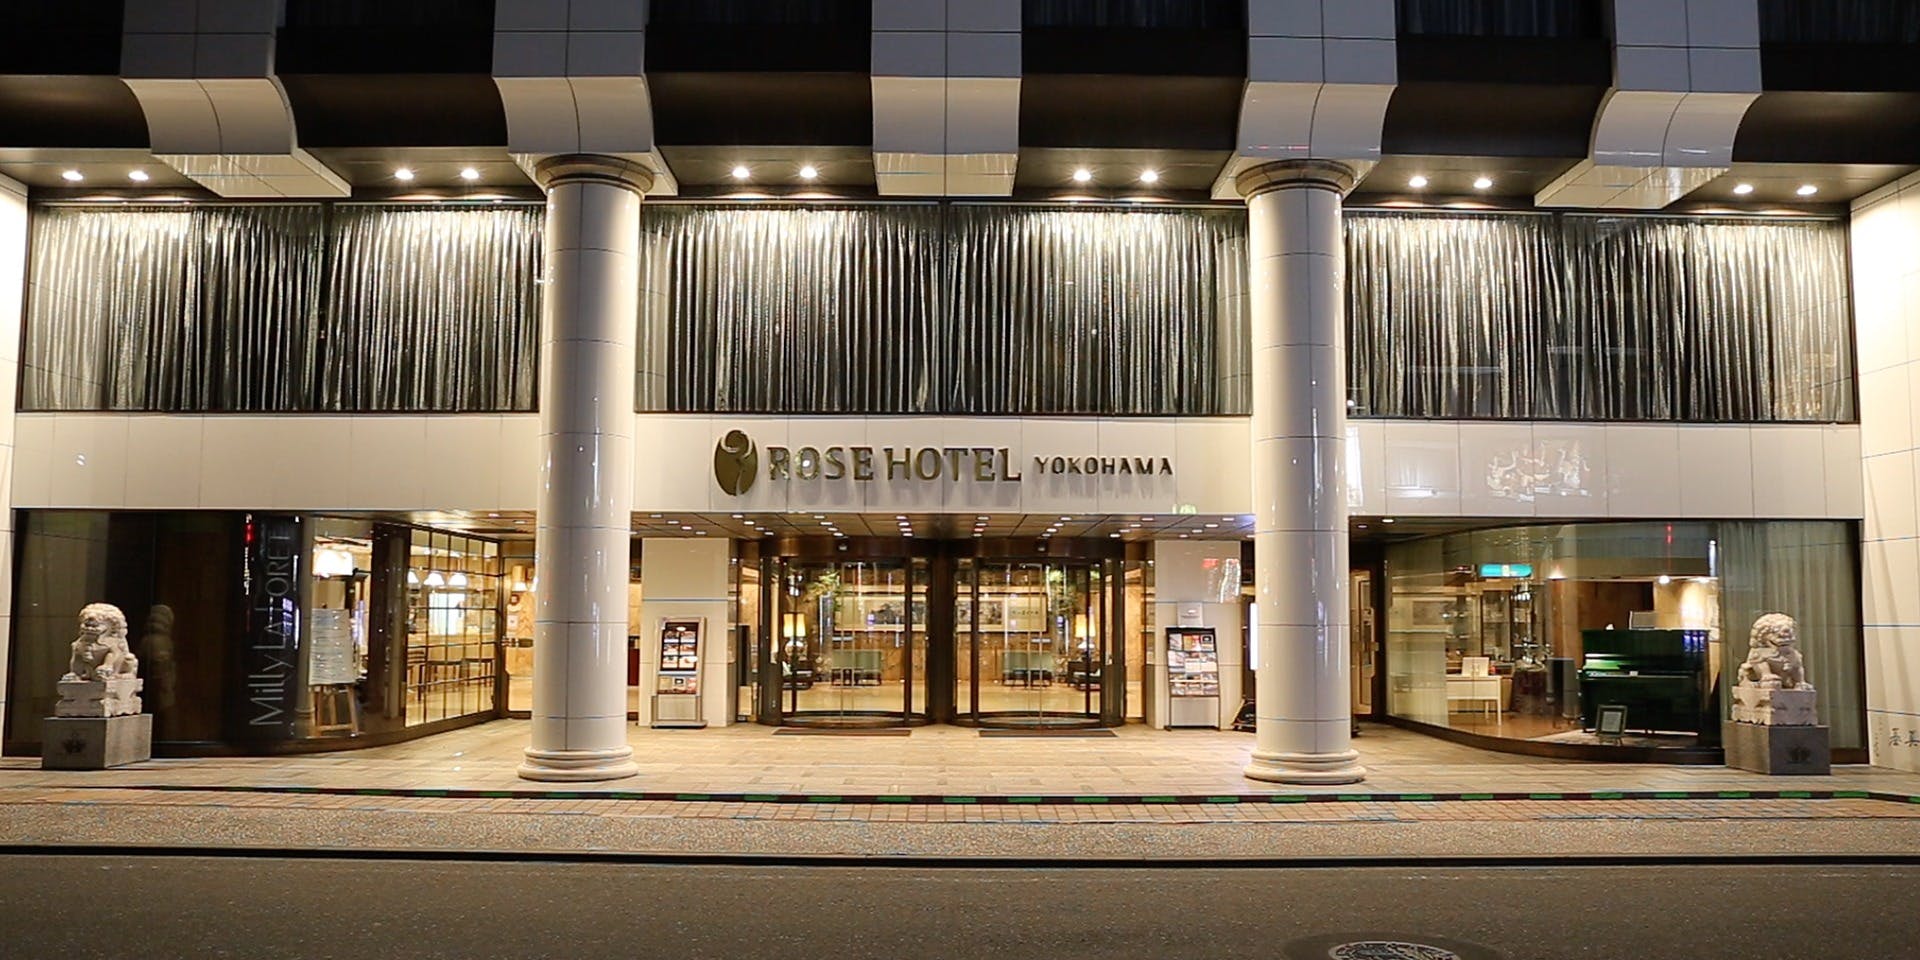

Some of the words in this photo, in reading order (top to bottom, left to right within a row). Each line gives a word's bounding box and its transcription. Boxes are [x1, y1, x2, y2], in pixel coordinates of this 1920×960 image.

[766, 446, 874, 481] ROSE
[883, 447, 1022, 482] HOTEL
[1033, 456, 1173, 475] YOKOHAMA
[248, 654, 294, 725] Milly
